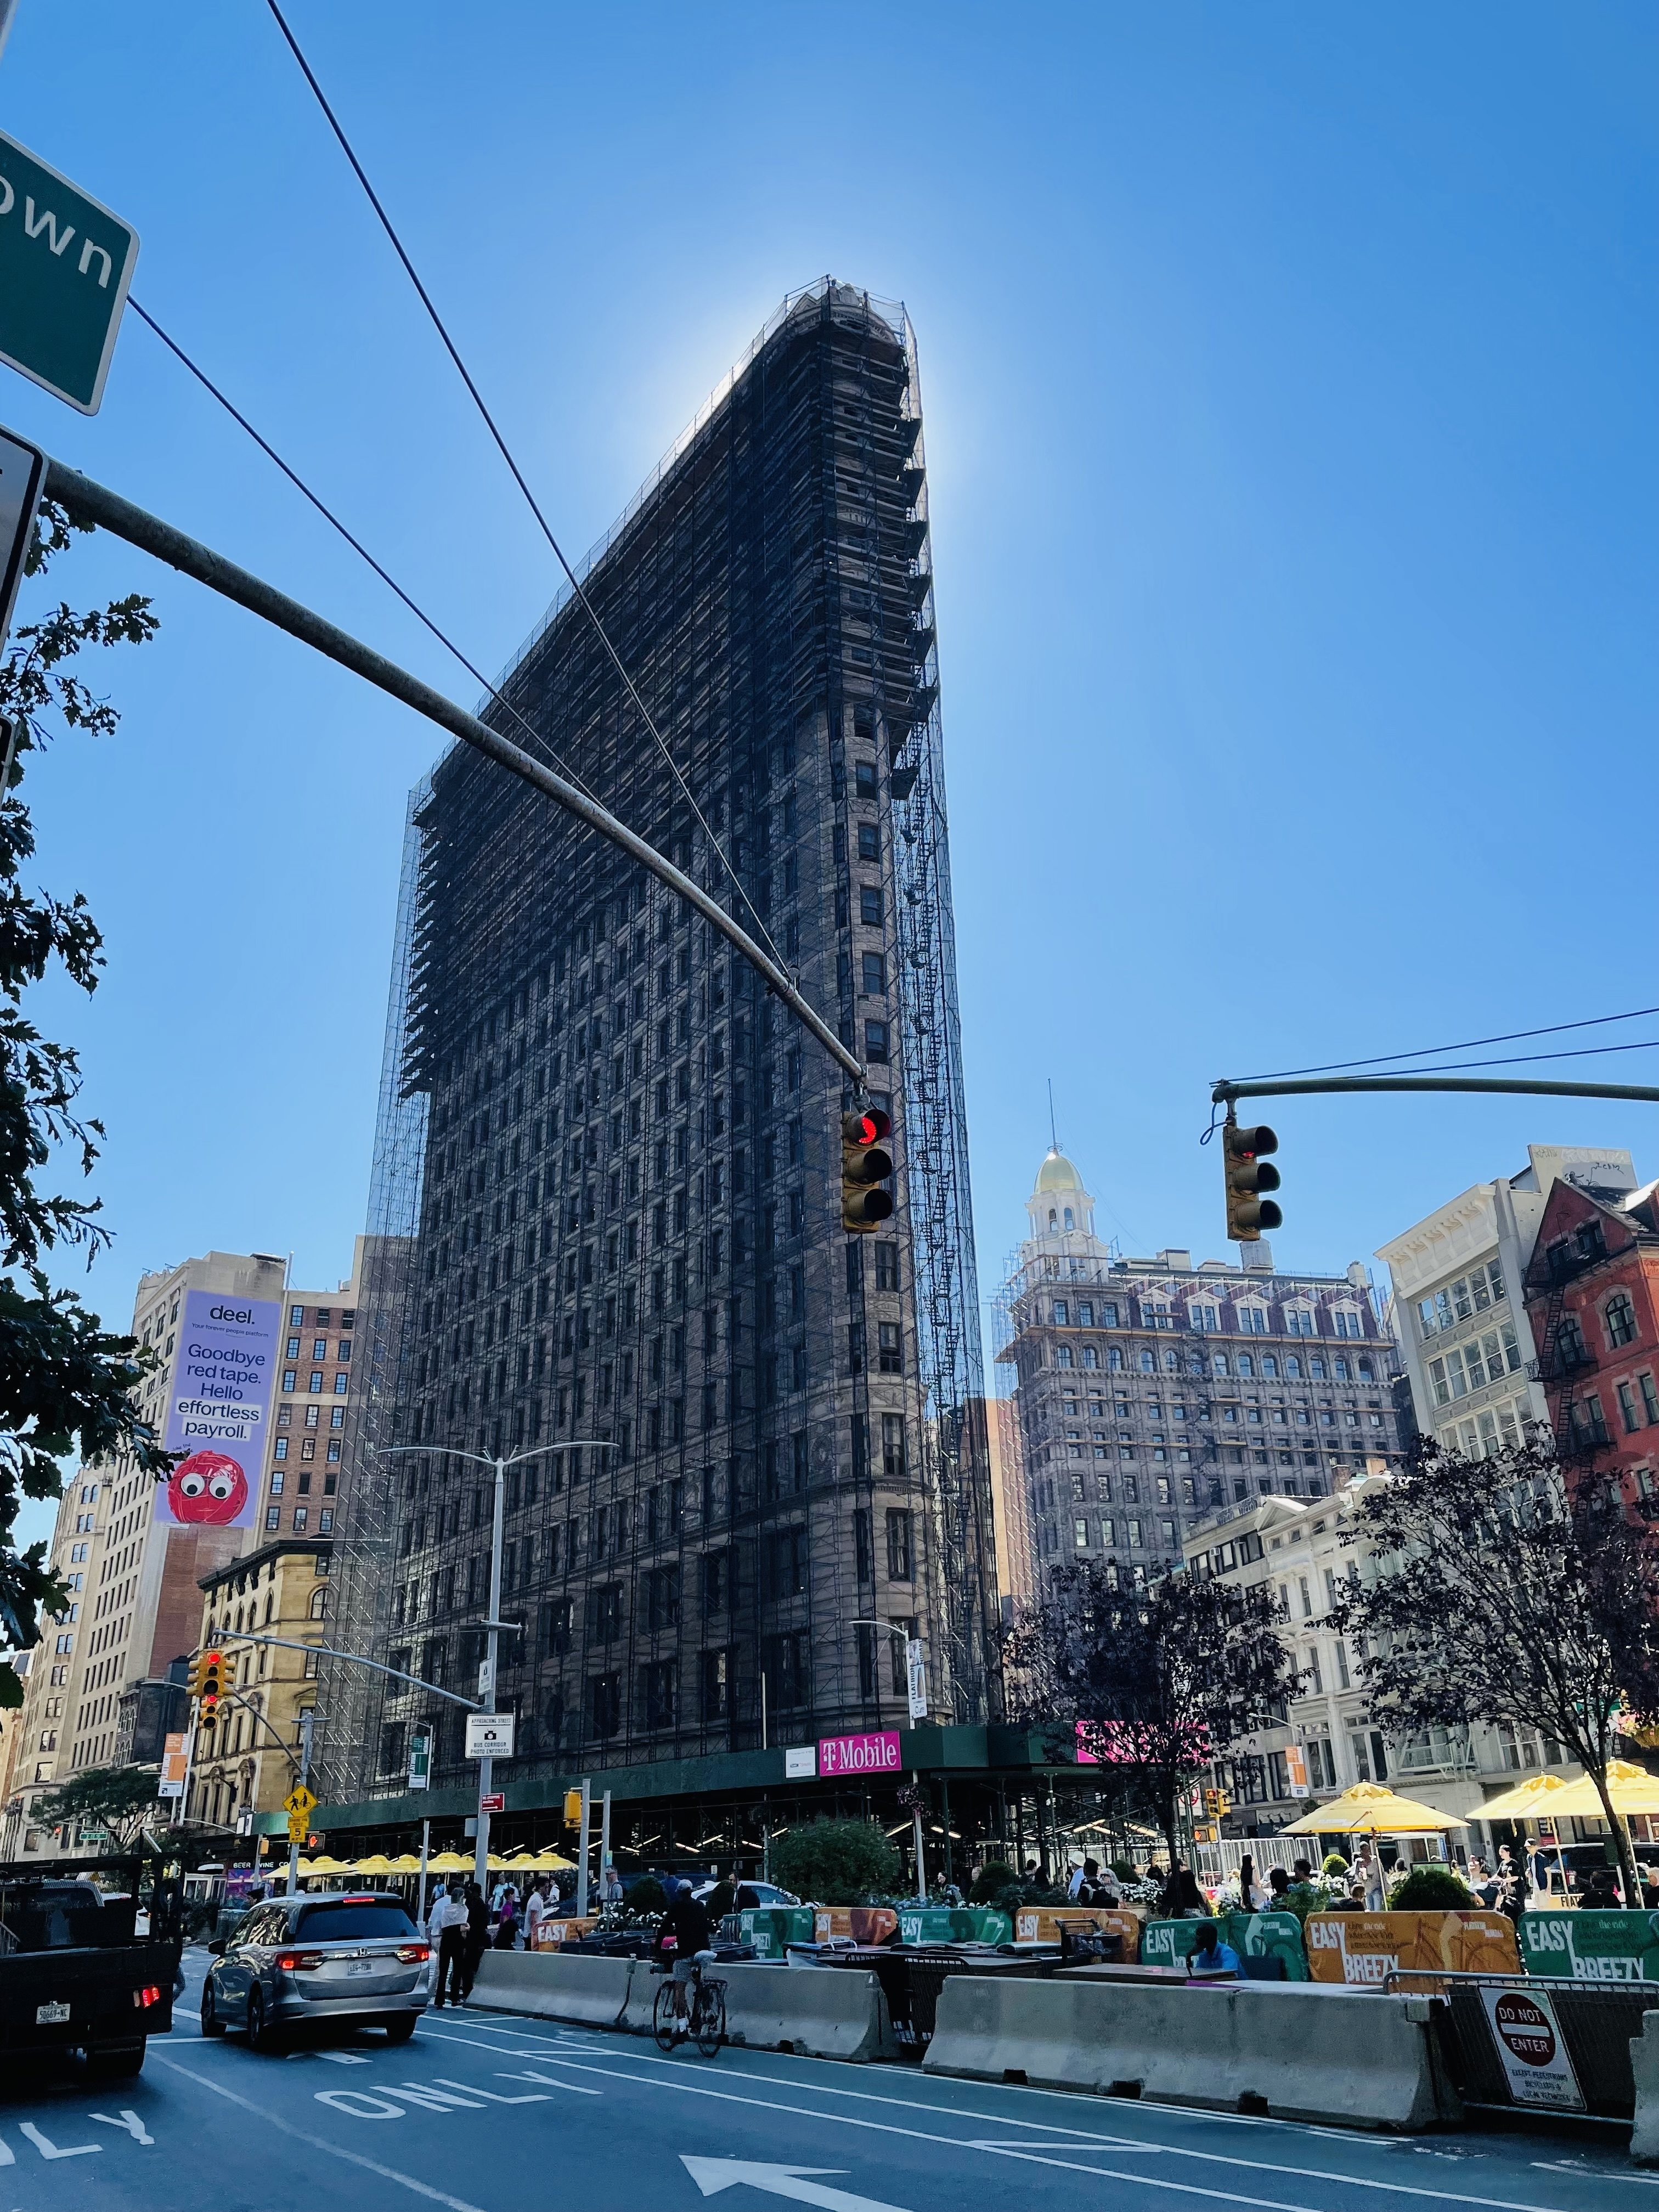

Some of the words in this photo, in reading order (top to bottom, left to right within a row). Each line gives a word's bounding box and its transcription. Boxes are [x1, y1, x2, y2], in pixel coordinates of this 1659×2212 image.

[210, 1305, 255, 1325] deel.
[188, 1344, 265, 1367] Goodbye
[187, 1365, 217, 1378] red
[219, 1367, 261, 1384] tape.
[201, 1383, 243, 1400] Hello
[178, 1401, 259, 1421] effortless
[185, 1422, 247, 1438] payroll.
[838, 1736, 897, 1770] Mobile
[295, 1828, 301, 1836] 5
[538, 1923, 568, 1942] EASY
[901, 1917, 923, 1937] EASY
[1310, 1922, 1346, 1949] EASY
[1525, 1920, 1573, 1951] EASY
[1147, 1928, 1175, 1954] EASY
[1343, 1954, 1399, 1984] BREEZY
[1498, 2007, 1515, 2020] DO
[1518, 2008, 1541, 2022] NOT
[1510, 2038, 1548, 2052] ENTER
[314, 2070, 604, 2119] ONLY
